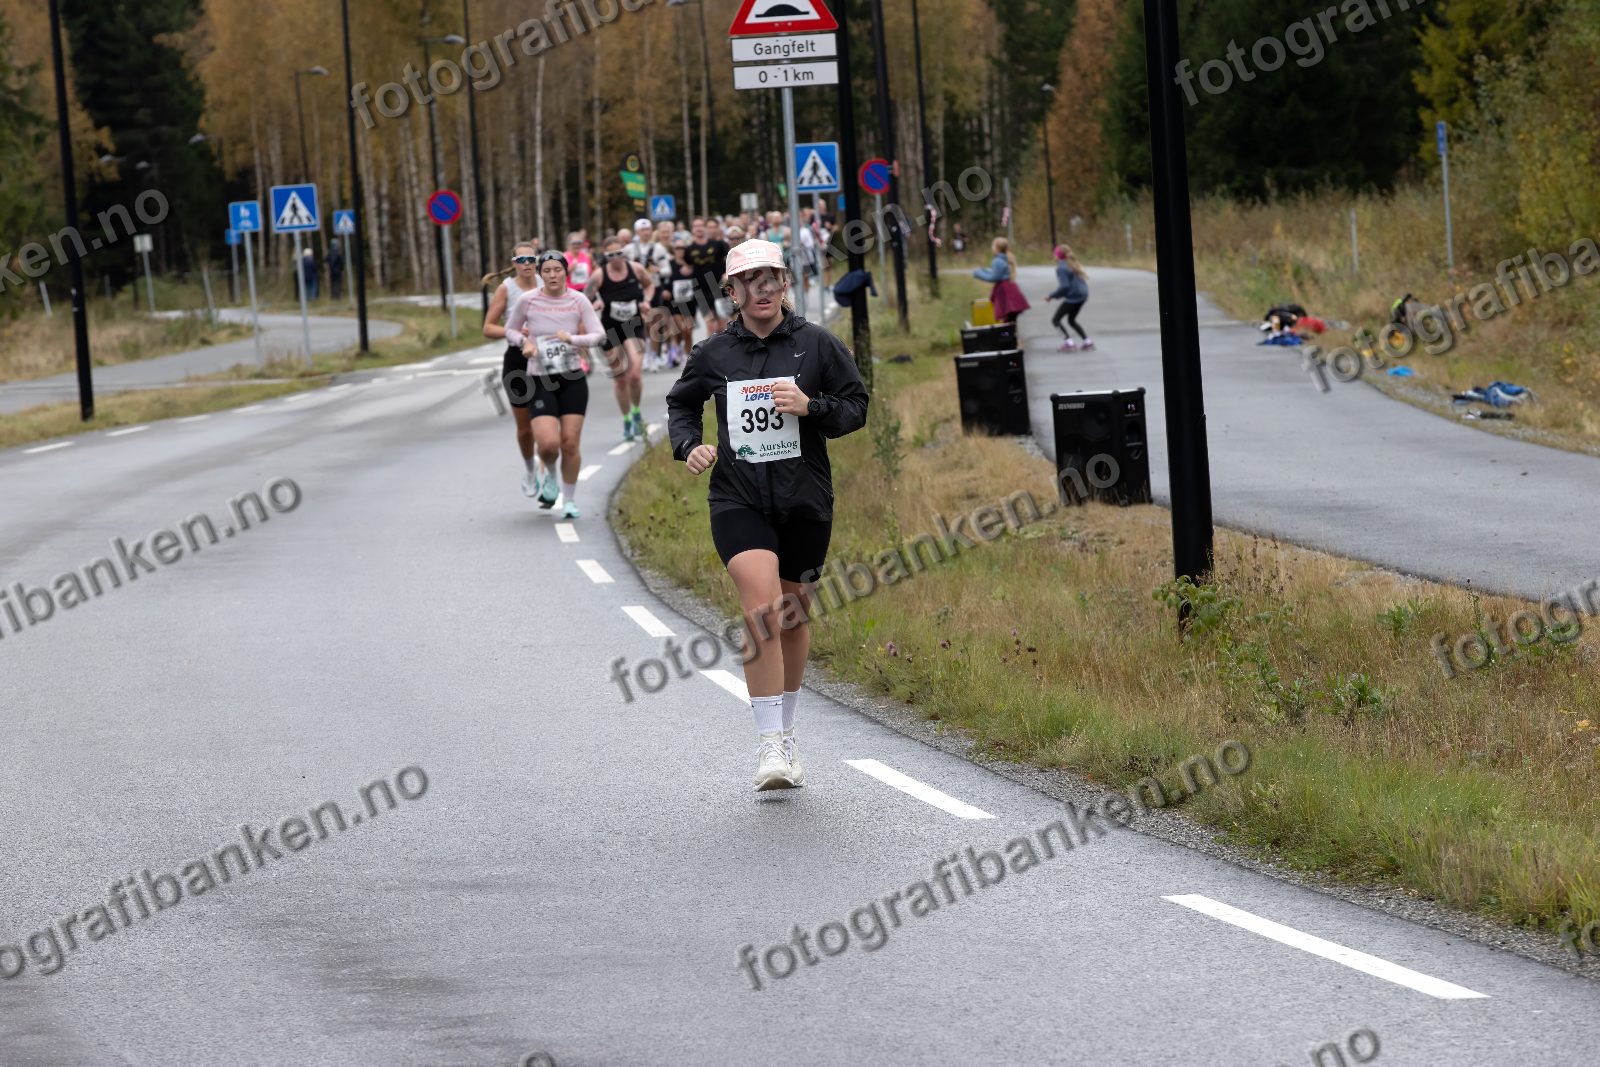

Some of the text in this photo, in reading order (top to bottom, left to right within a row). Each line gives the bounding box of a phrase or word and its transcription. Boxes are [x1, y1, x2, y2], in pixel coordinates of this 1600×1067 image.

[753, 40, 816, 57] Gangfelt
[741, 407, 784, 433] 393
[760, 440, 798, 452] Aurskog
